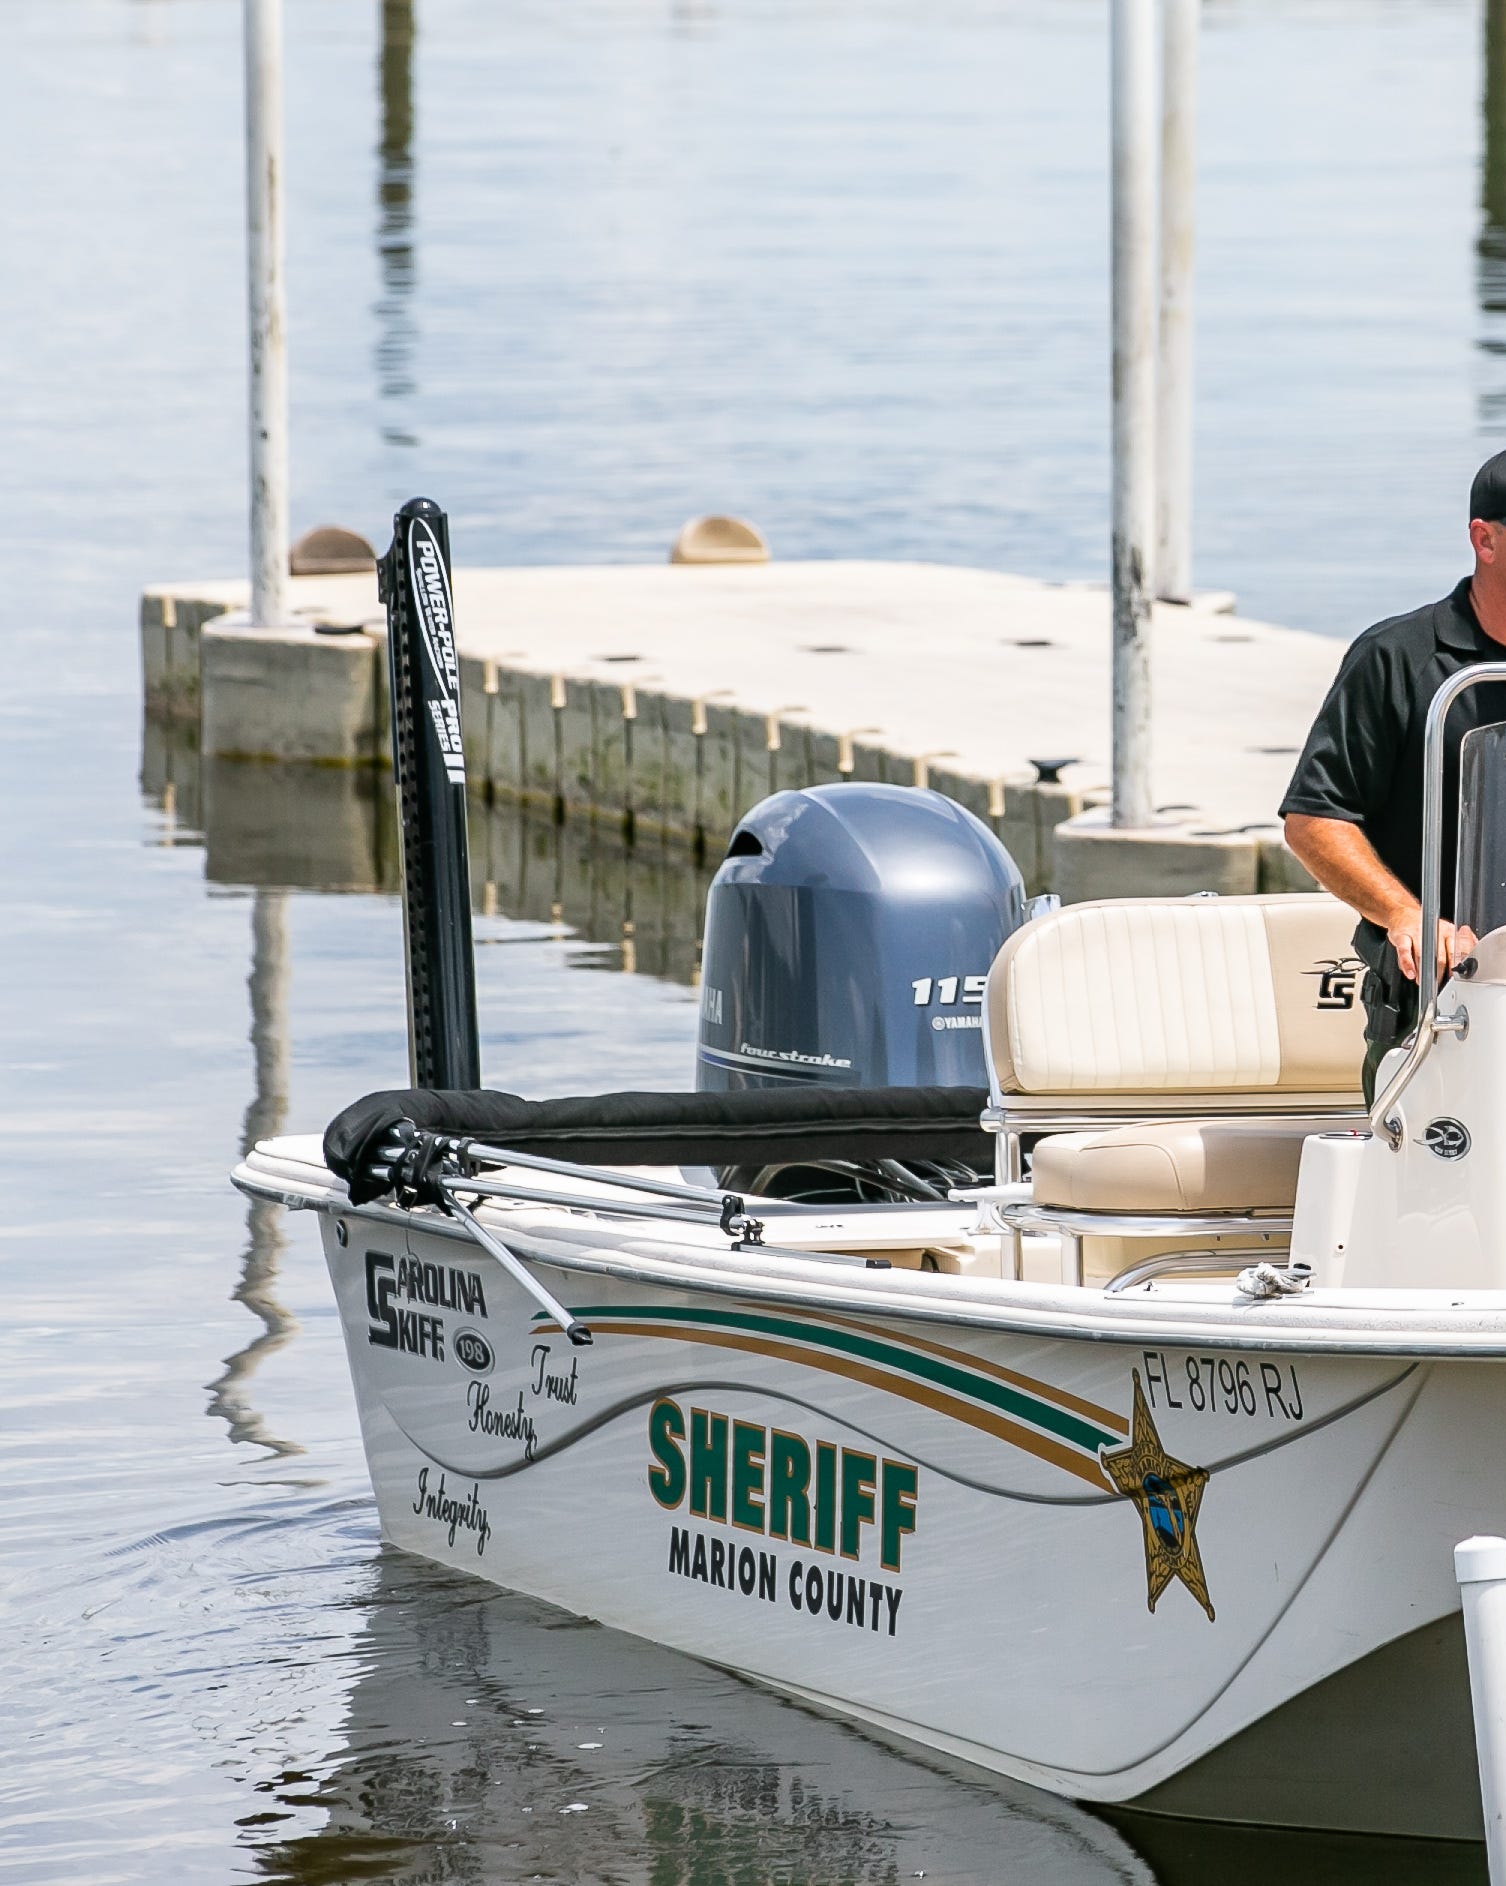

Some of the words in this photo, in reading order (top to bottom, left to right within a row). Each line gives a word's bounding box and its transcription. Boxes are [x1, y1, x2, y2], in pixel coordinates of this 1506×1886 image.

[416, 540, 459, 690] POWER-POLE
[427, 699, 451, 752] SERIES
[440, 699, 462, 752] PRO
[911, 975, 988, 1005] 115
[944, 1015, 983, 1029] YAMAH
[365, 1249, 489, 1319] CAROLINA
[459, 1338, 486, 1364] 198
[530, 1344, 578, 1406] Trust
[1142, 1350, 1183, 1409] FL
[1185, 1355, 1257, 1416] 8796
[1260, 1362, 1304, 1421] RJ
[647, 1396, 919, 1574] SHERIFF
[668, 1526, 777, 1602] MARION
[788, 1560, 904, 1637] COUNTY
